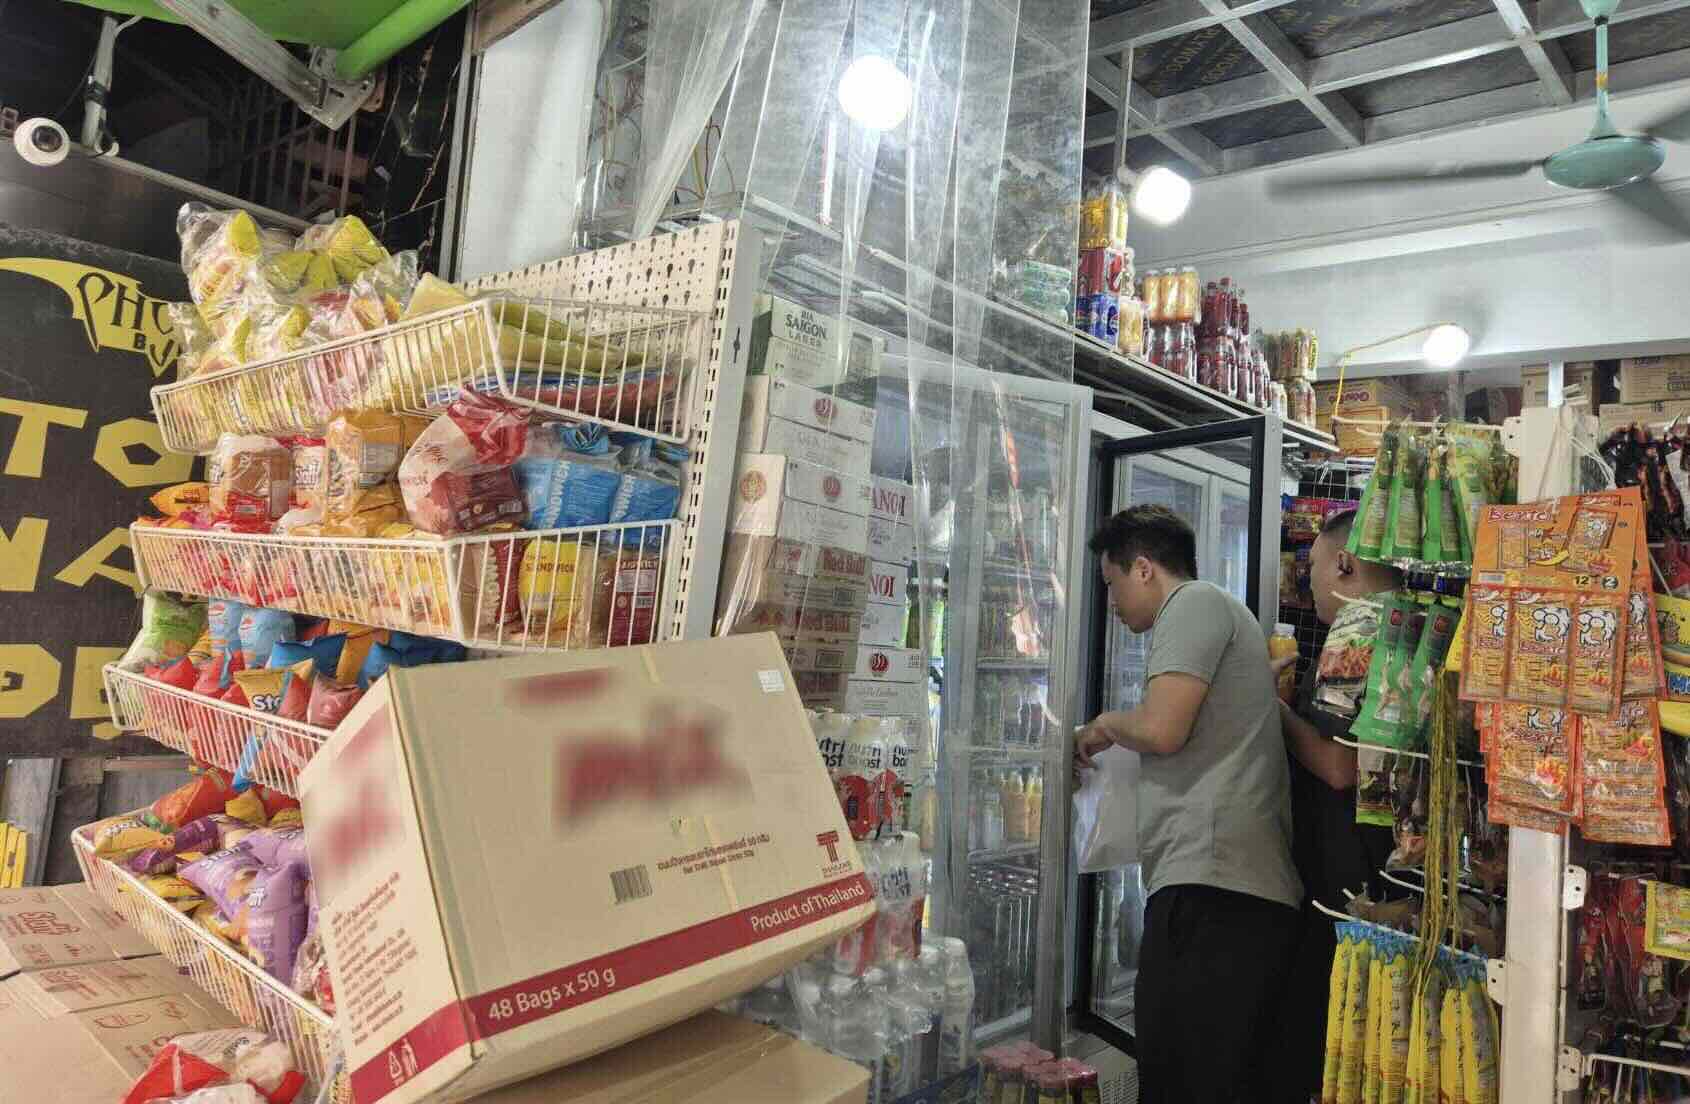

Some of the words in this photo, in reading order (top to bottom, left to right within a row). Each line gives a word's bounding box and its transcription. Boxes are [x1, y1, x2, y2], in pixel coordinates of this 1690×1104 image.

[785, 313, 826, 338] SAIGON
[1575, 575, 1590, 585] 12
[751, 904, 800, 932] Product
[801, 897, 815, 915] of
[812, 881, 865, 910] Thailand
[489, 998, 513, 1022] 48
[515, 984, 561, 1013] Bags
[563, 980, 577, 998] x
[577, 969, 600, 993] 50
[602, 967, 616, 988] g
